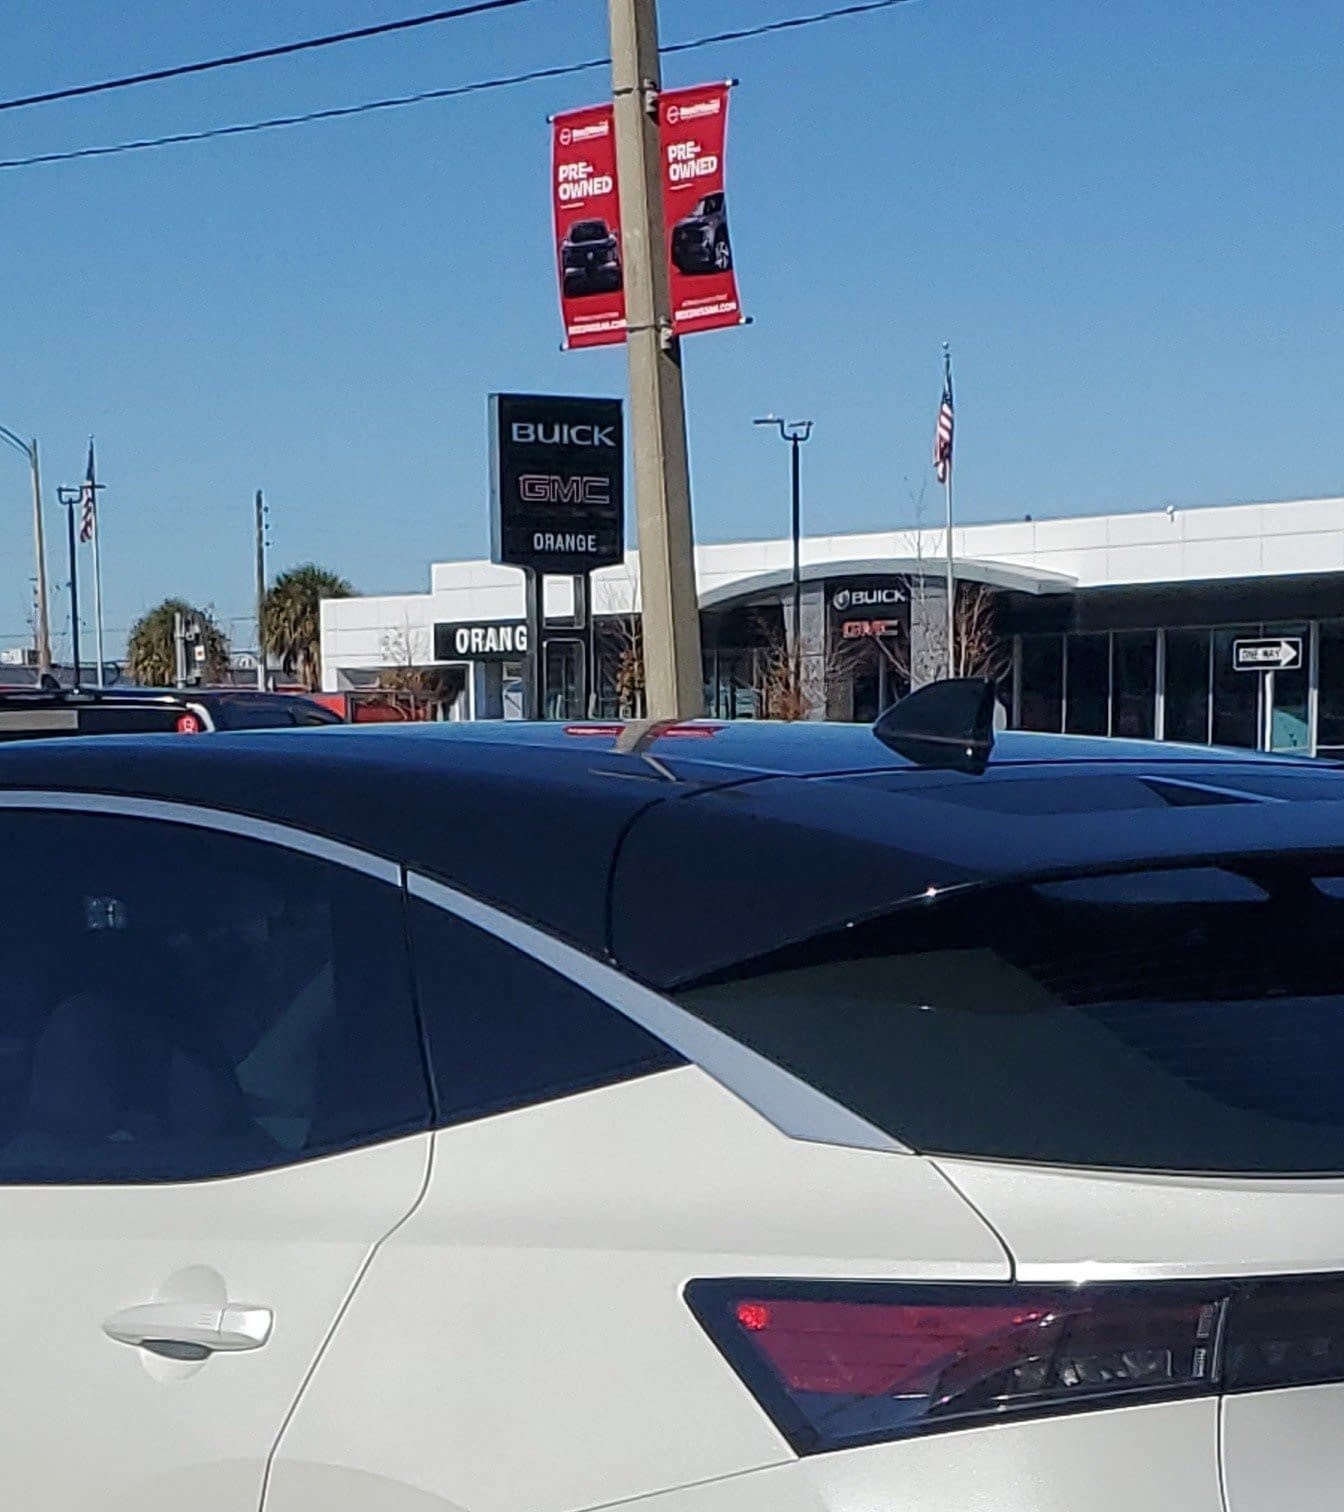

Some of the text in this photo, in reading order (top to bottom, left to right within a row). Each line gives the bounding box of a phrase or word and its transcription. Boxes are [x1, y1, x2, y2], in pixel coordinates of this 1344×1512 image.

[667, 141, 701, 162] PRE-
[558, 161, 594, 182] PRE-
[669, 156, 718, 181] OWNED
[558, 176, 613, 200] OWNED
[511, 422, 616, 447] BUICK
[518, 474, 610, 504] GMC
[533, 532, 597, 552] ORANGE
[851, 589, 906, 605] BUICK
[455, 625, 528, 654] ORANG
